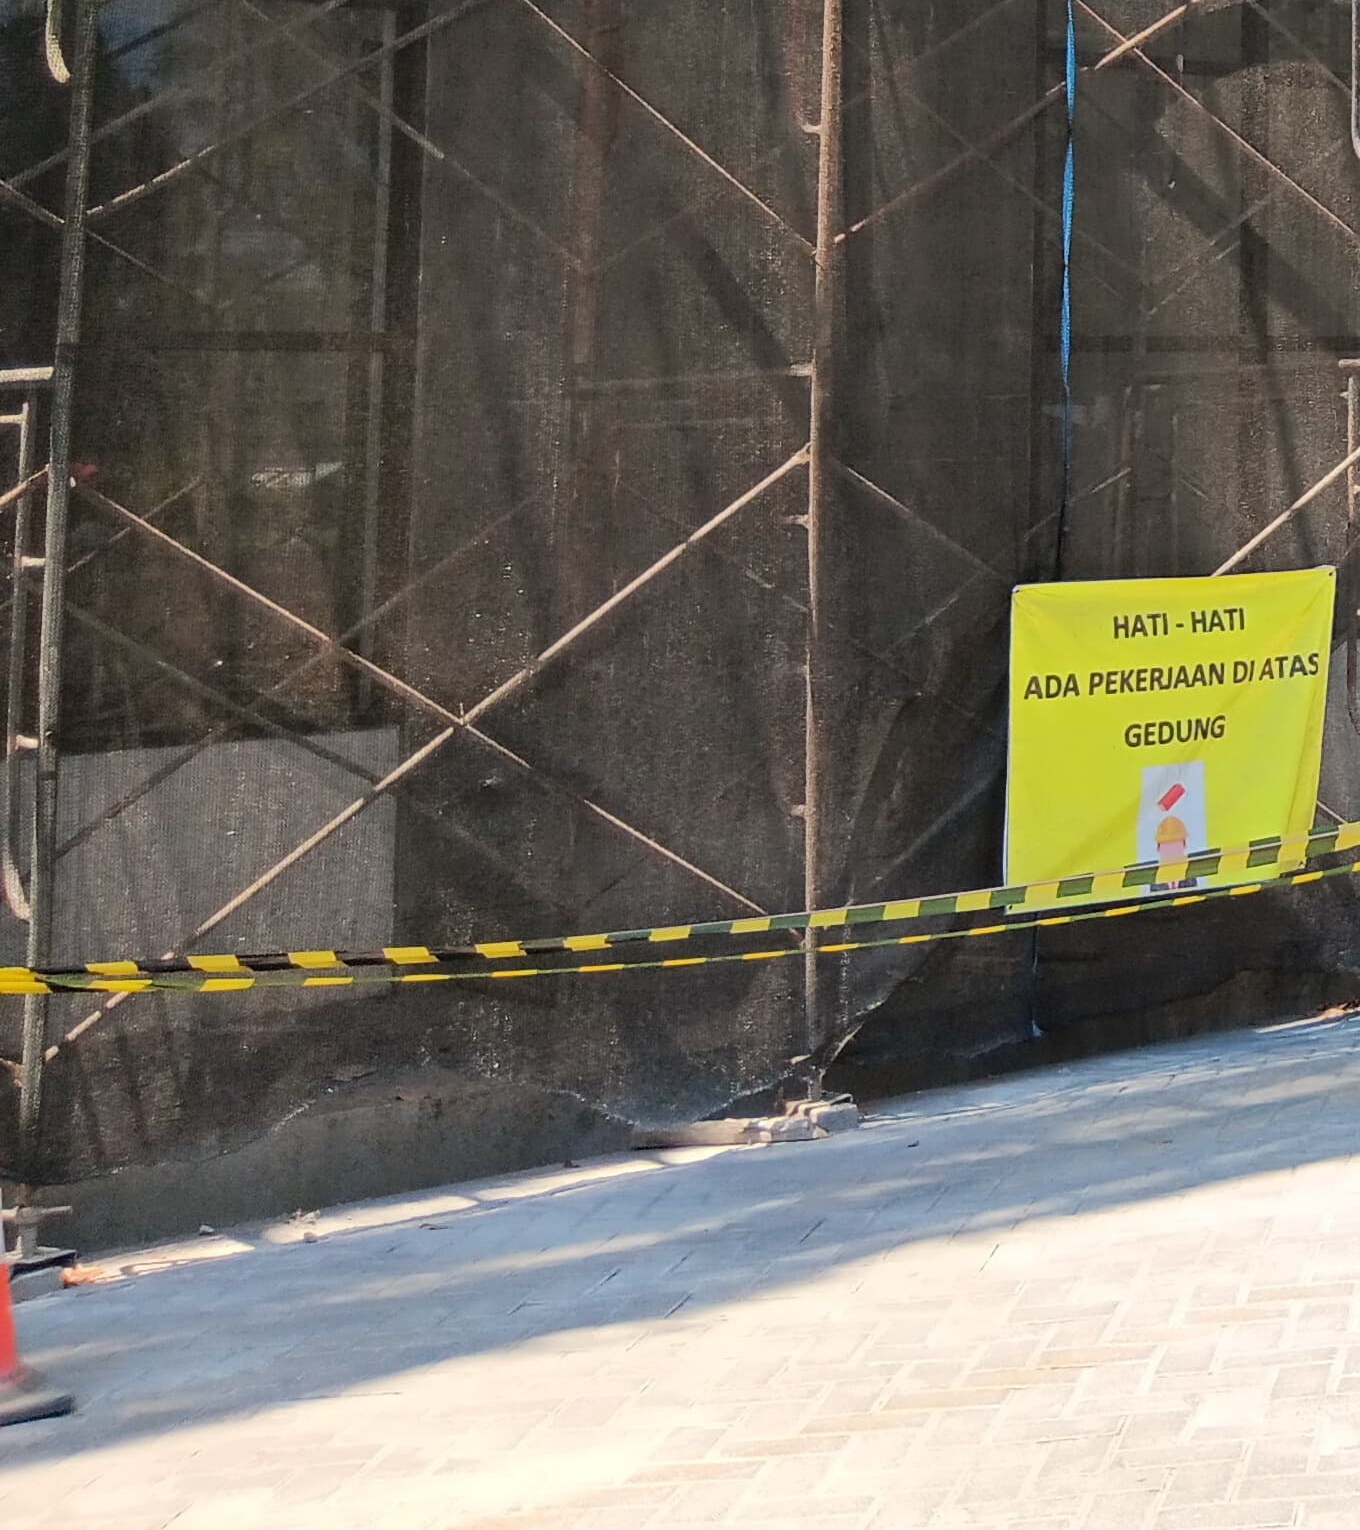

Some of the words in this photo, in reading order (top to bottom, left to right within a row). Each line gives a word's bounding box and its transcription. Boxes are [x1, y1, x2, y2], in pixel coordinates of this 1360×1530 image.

[1113, 614, 1169, 639] HATI
[1191, 608, 1245, 633] HATI
[1024, 673, 1080, 700] ADA
[1088, 663, 1225, 696] PEKERJAAN
[1233, 660, 1254, 683] DI
[1260, 653, 1319, 681] ATAS
[1124, 716, 1226, 747] GEDUNG
